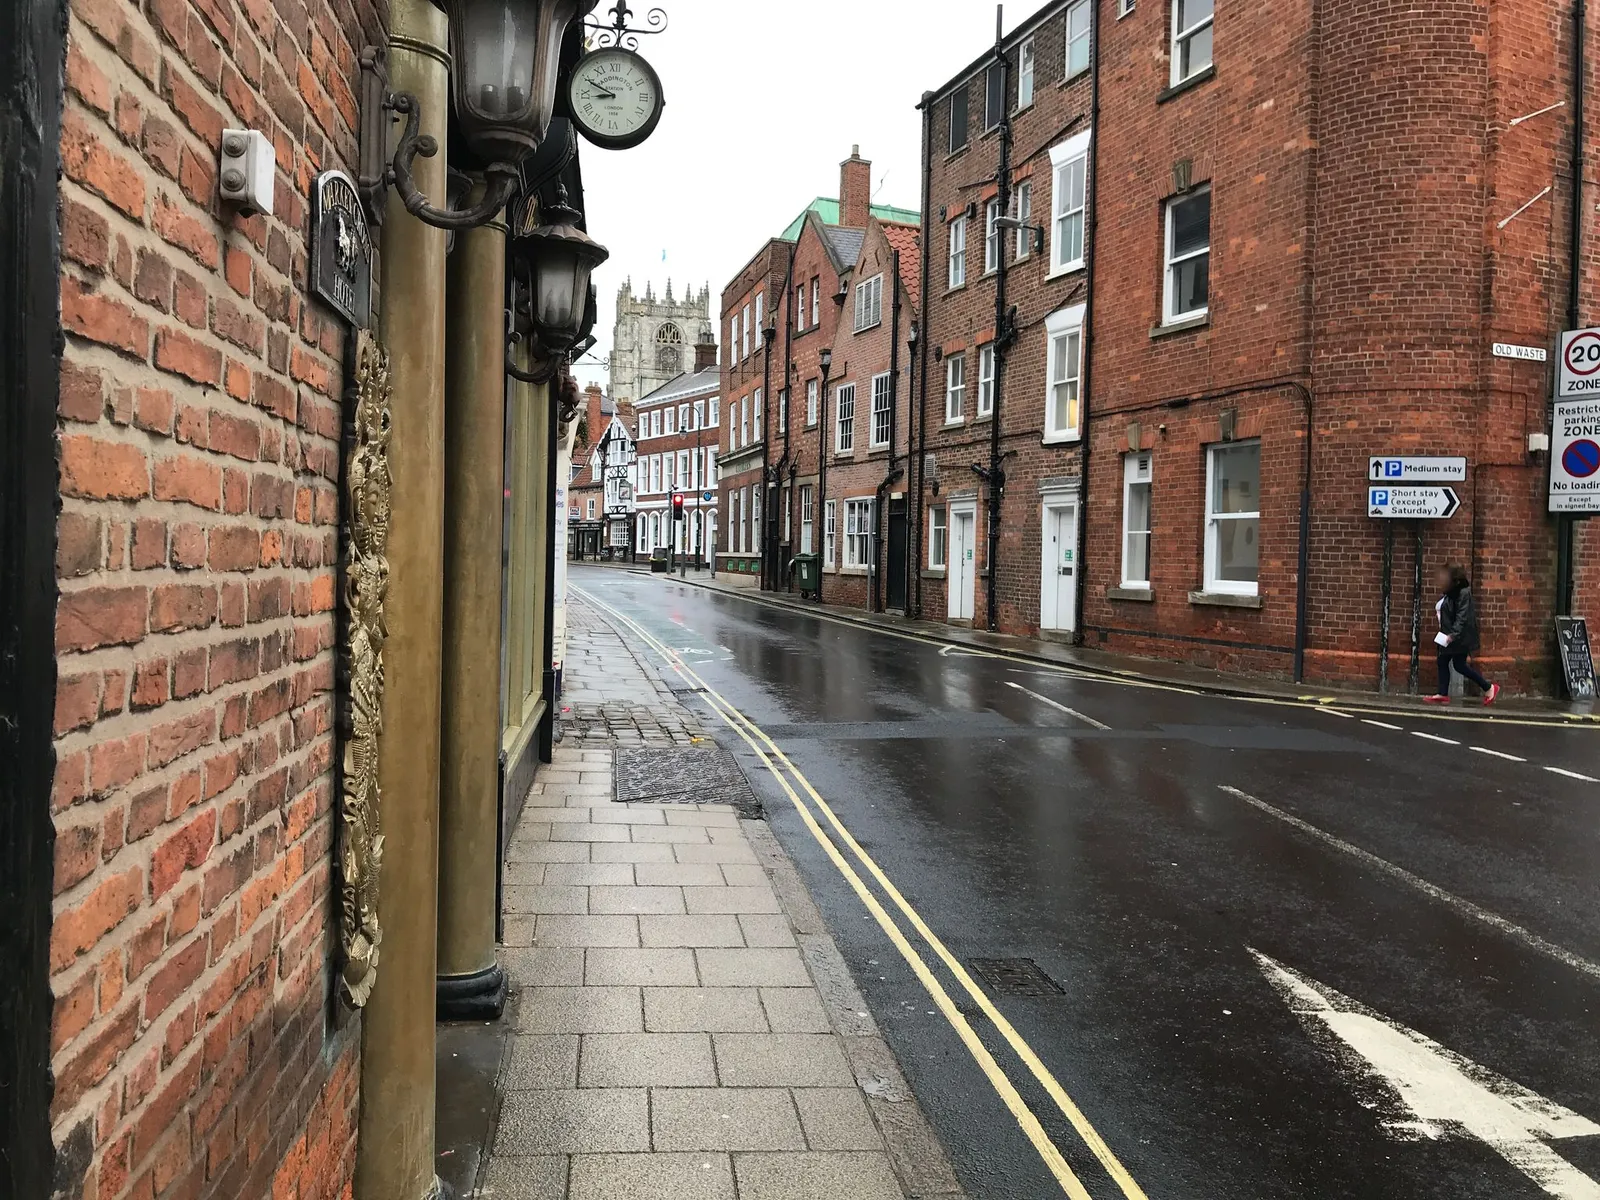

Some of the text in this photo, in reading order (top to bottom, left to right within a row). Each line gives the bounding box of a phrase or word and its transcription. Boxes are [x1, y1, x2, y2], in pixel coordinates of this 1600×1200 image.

[597, 75, 634, 91] PADDINGTON
[321, 180, 354, 214] MARKET
[333, 272, 356, 316] HOTEL
[1495, 345, 1544, 360] OLD WASTE
[1572, 344, 1600, 363] 20
[1567, 380, 1600, 391] ZONE
[1564, 415, 1600, 426] parking
[1564, 425, 1600, 437] ZONE
[1404, 464, 1440, 473] Medium
[1443, 465, 1462, 474] stay
[1553, 482, 1567, 490] No
[1391, 489, 1416, 497] Short
[1420, 490, 1439, 498] stay
[1391, 498, 1426, 507] (except
[1391, 506, 1438, 516] Saturday)
